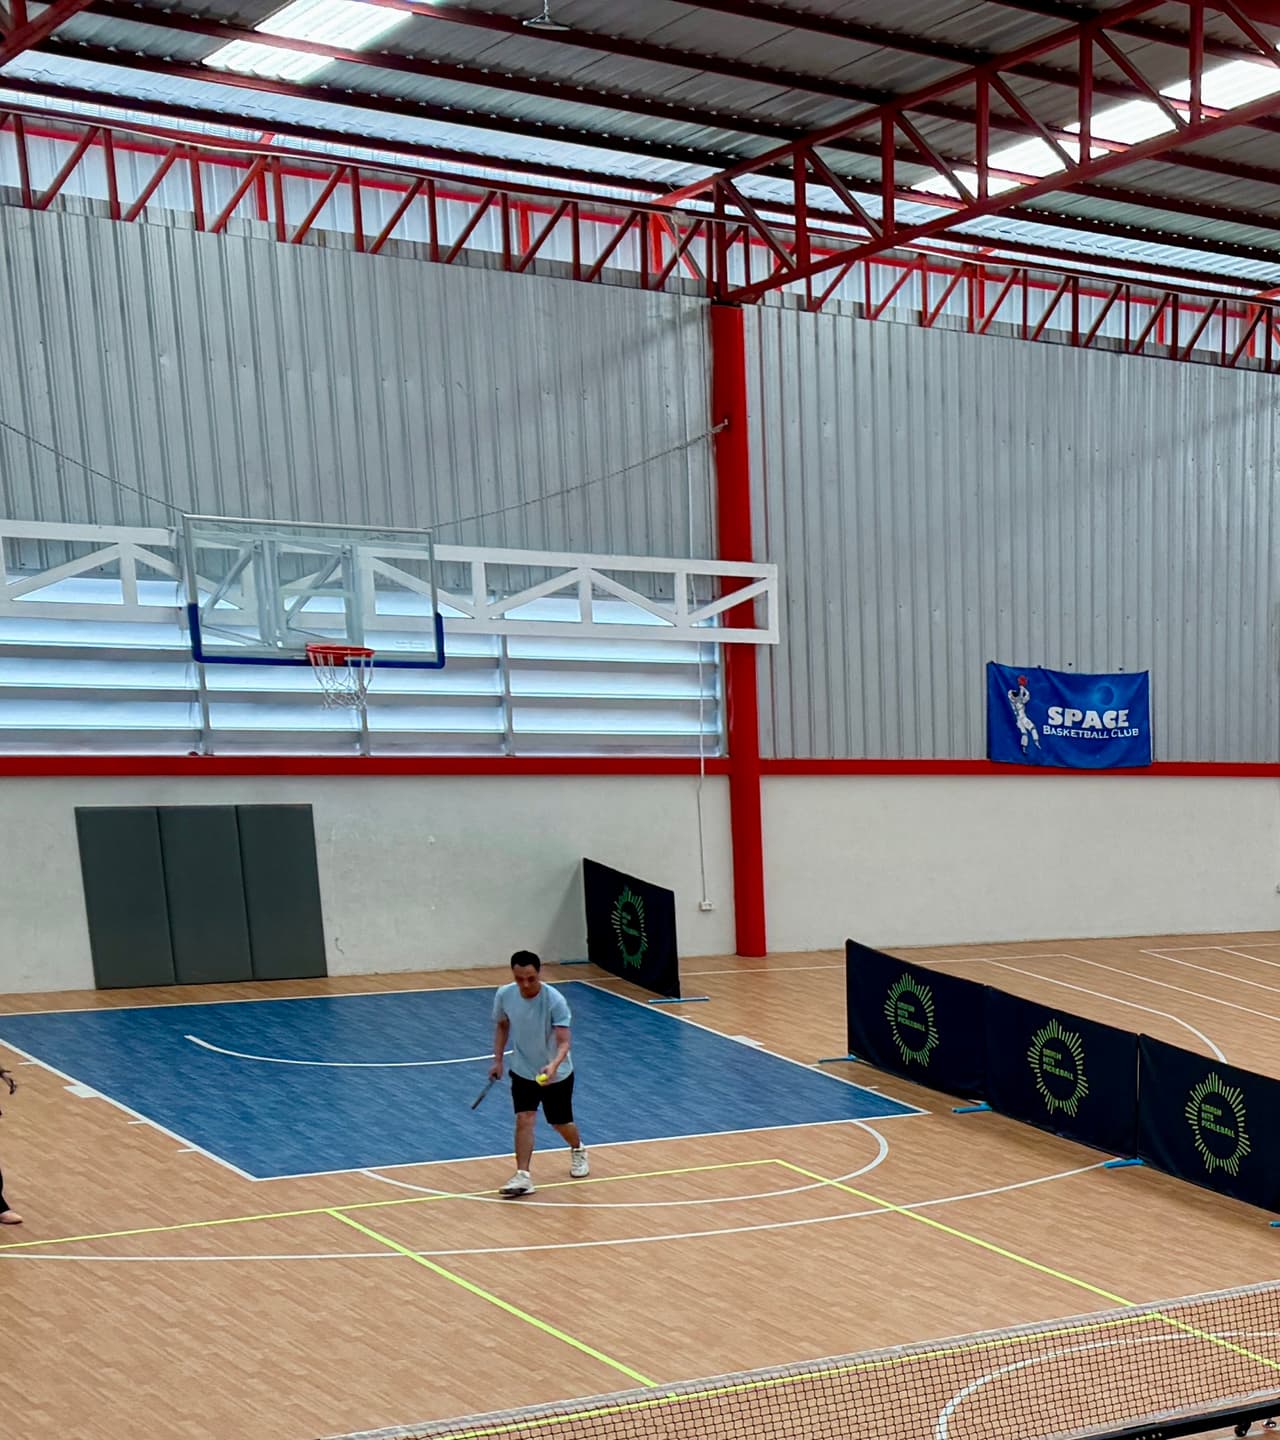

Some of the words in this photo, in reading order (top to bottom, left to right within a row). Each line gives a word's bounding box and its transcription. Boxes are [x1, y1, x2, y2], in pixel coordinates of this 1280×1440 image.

[1048, 706, 1129, 729] SPACE
[1043, 725, 1109, 739] BASKETBALL
[1111, 728, 1139, 738] CLUB
